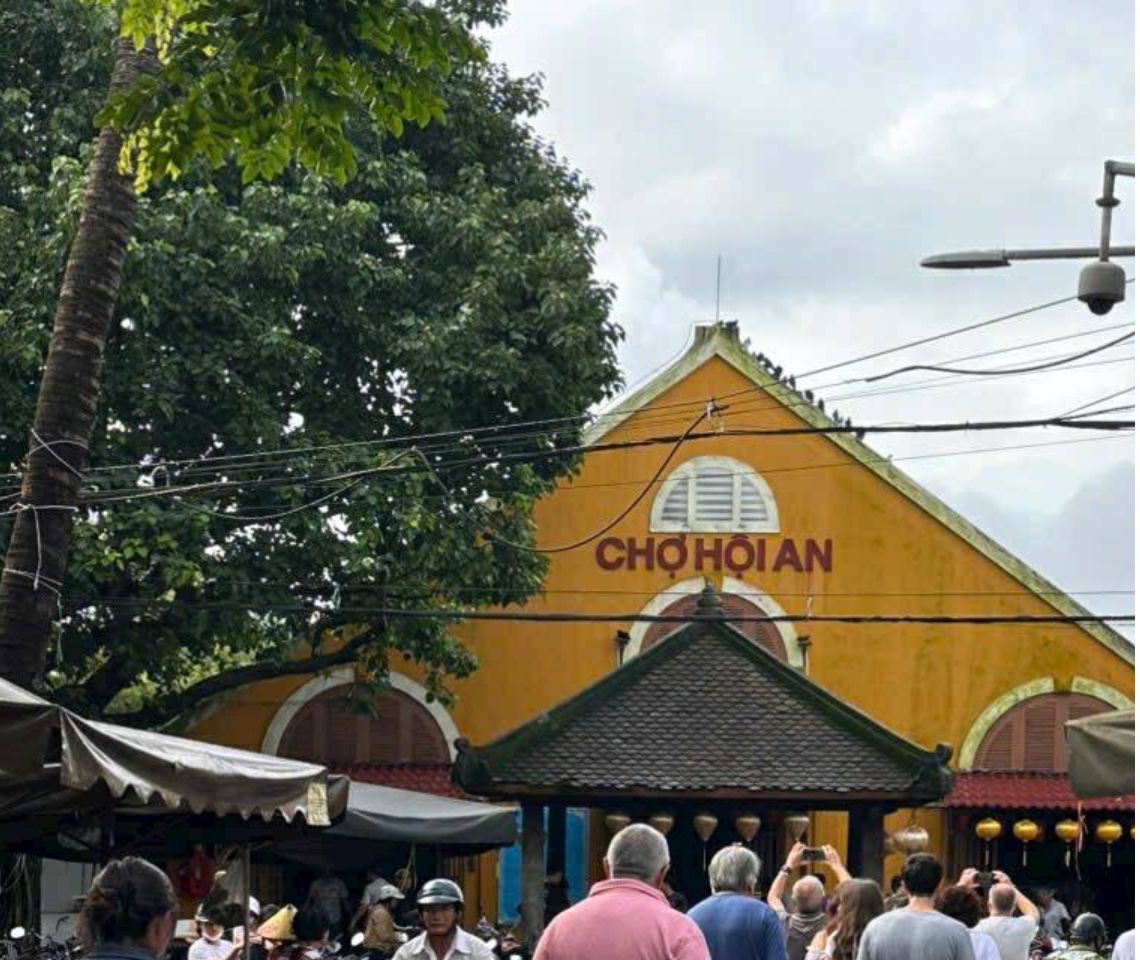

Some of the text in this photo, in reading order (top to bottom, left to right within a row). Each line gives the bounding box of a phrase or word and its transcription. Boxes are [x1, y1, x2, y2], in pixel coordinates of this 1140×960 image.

[595, 534, 833, 579] CHỢ HỘI AN
